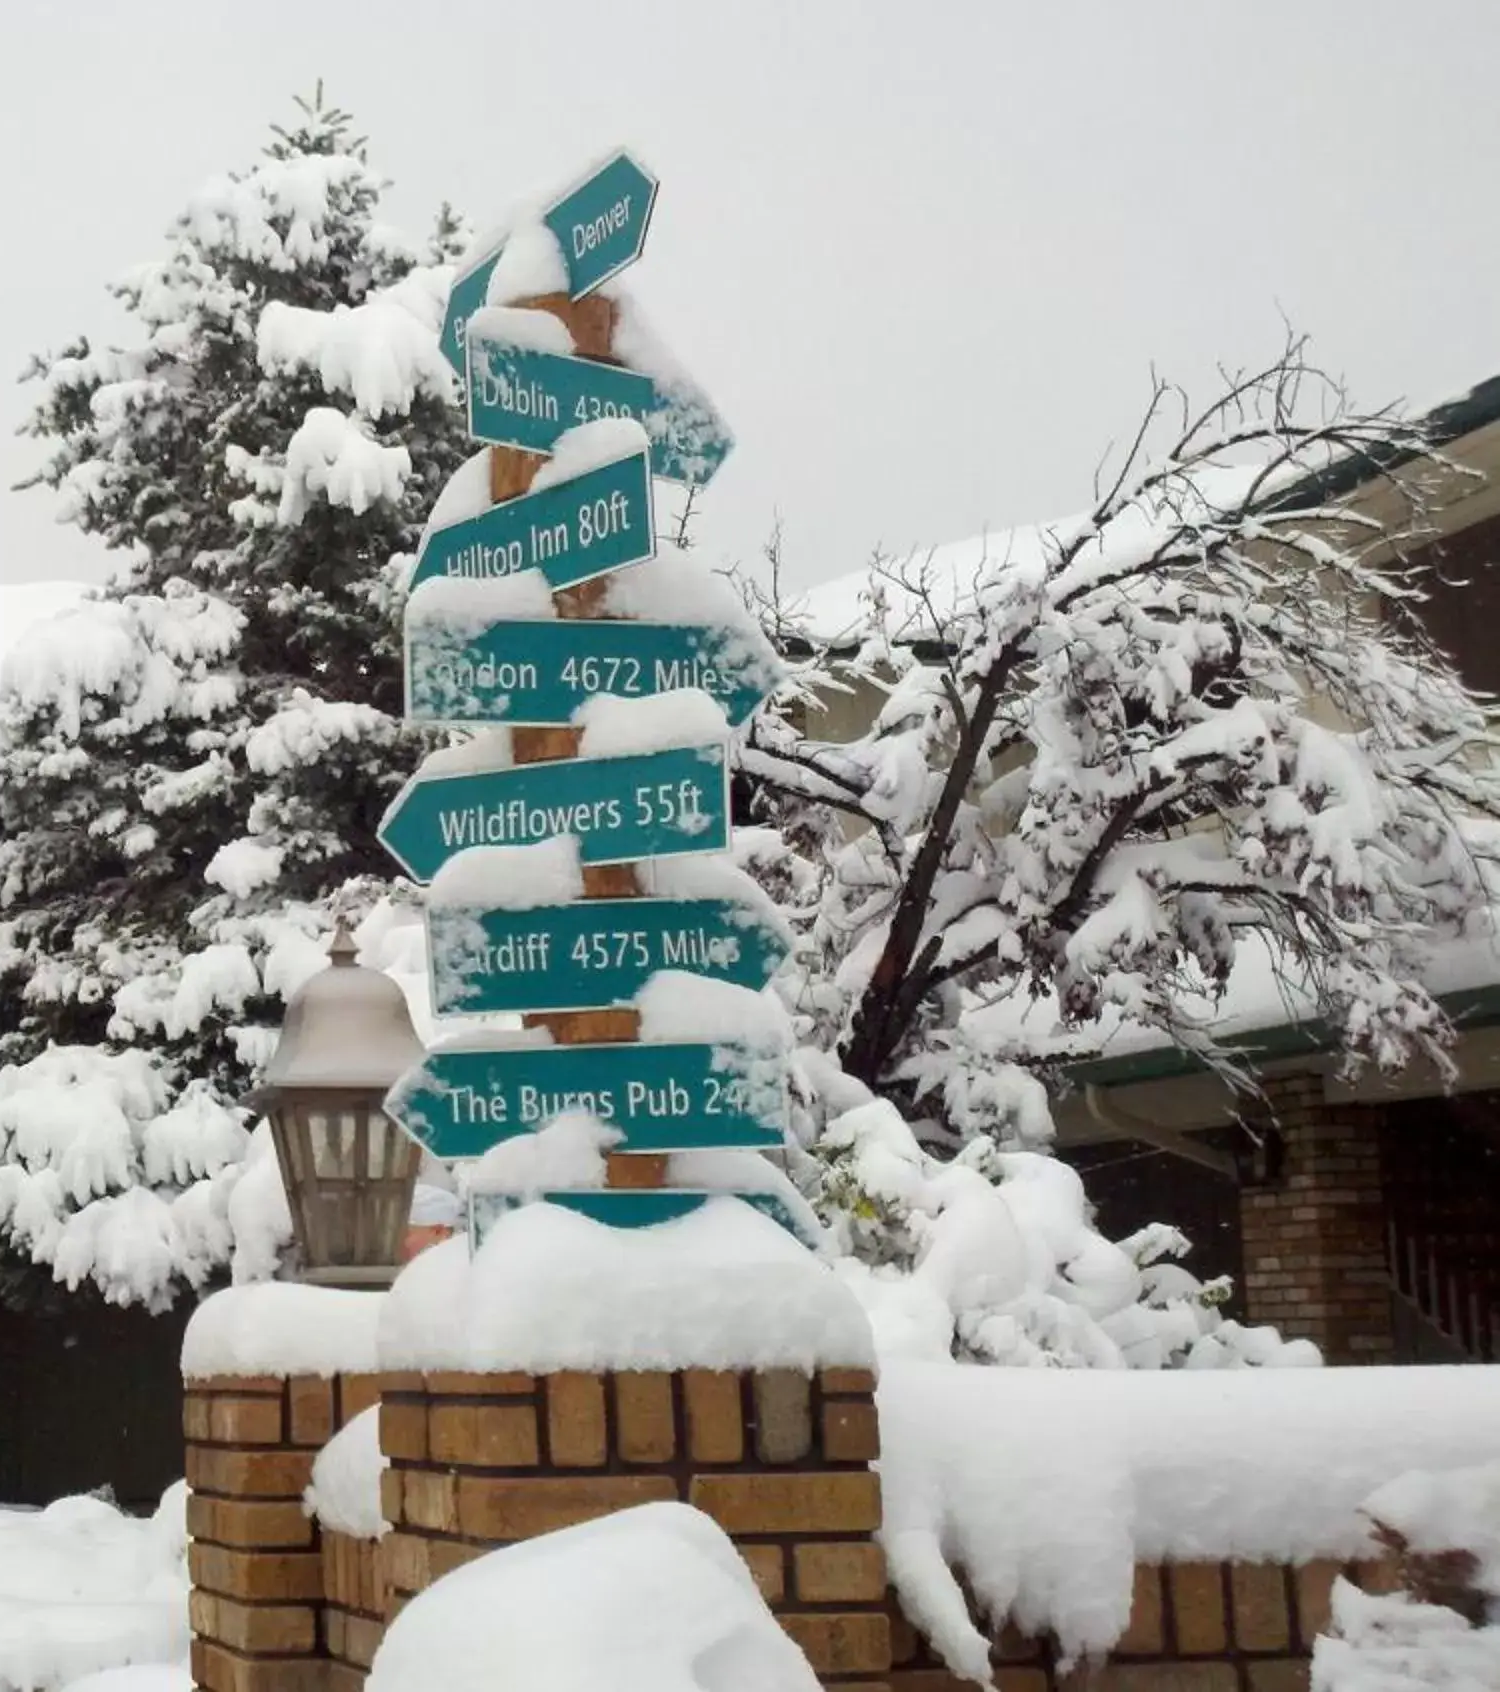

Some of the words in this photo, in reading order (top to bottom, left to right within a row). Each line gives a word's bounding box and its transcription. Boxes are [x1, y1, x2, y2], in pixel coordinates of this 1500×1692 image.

[572, 194, 632, 259] Denver
[481, 374, 559, 422] Dublin
[446, 539, 523, 578] Hilltop
[531, 524, 569, 563] Inn
[578, 489, 631, 548] 80ft
[436, 652, 538, 690] ondon
[560, 655, 642, 693] 4672
[655, 658, 738, 695] Miles
[439, 799, 622, 847] Wildflowers
[635, 778, 702, 827] 55ft
[466, 932, 551, 977] rdiff
[571, 930, 650, 970] 4575
[450, 1085, 508, 1124] The
[520, 1084, 615, 1124] Burns
[627, 1077, 691, 1117] Pub
